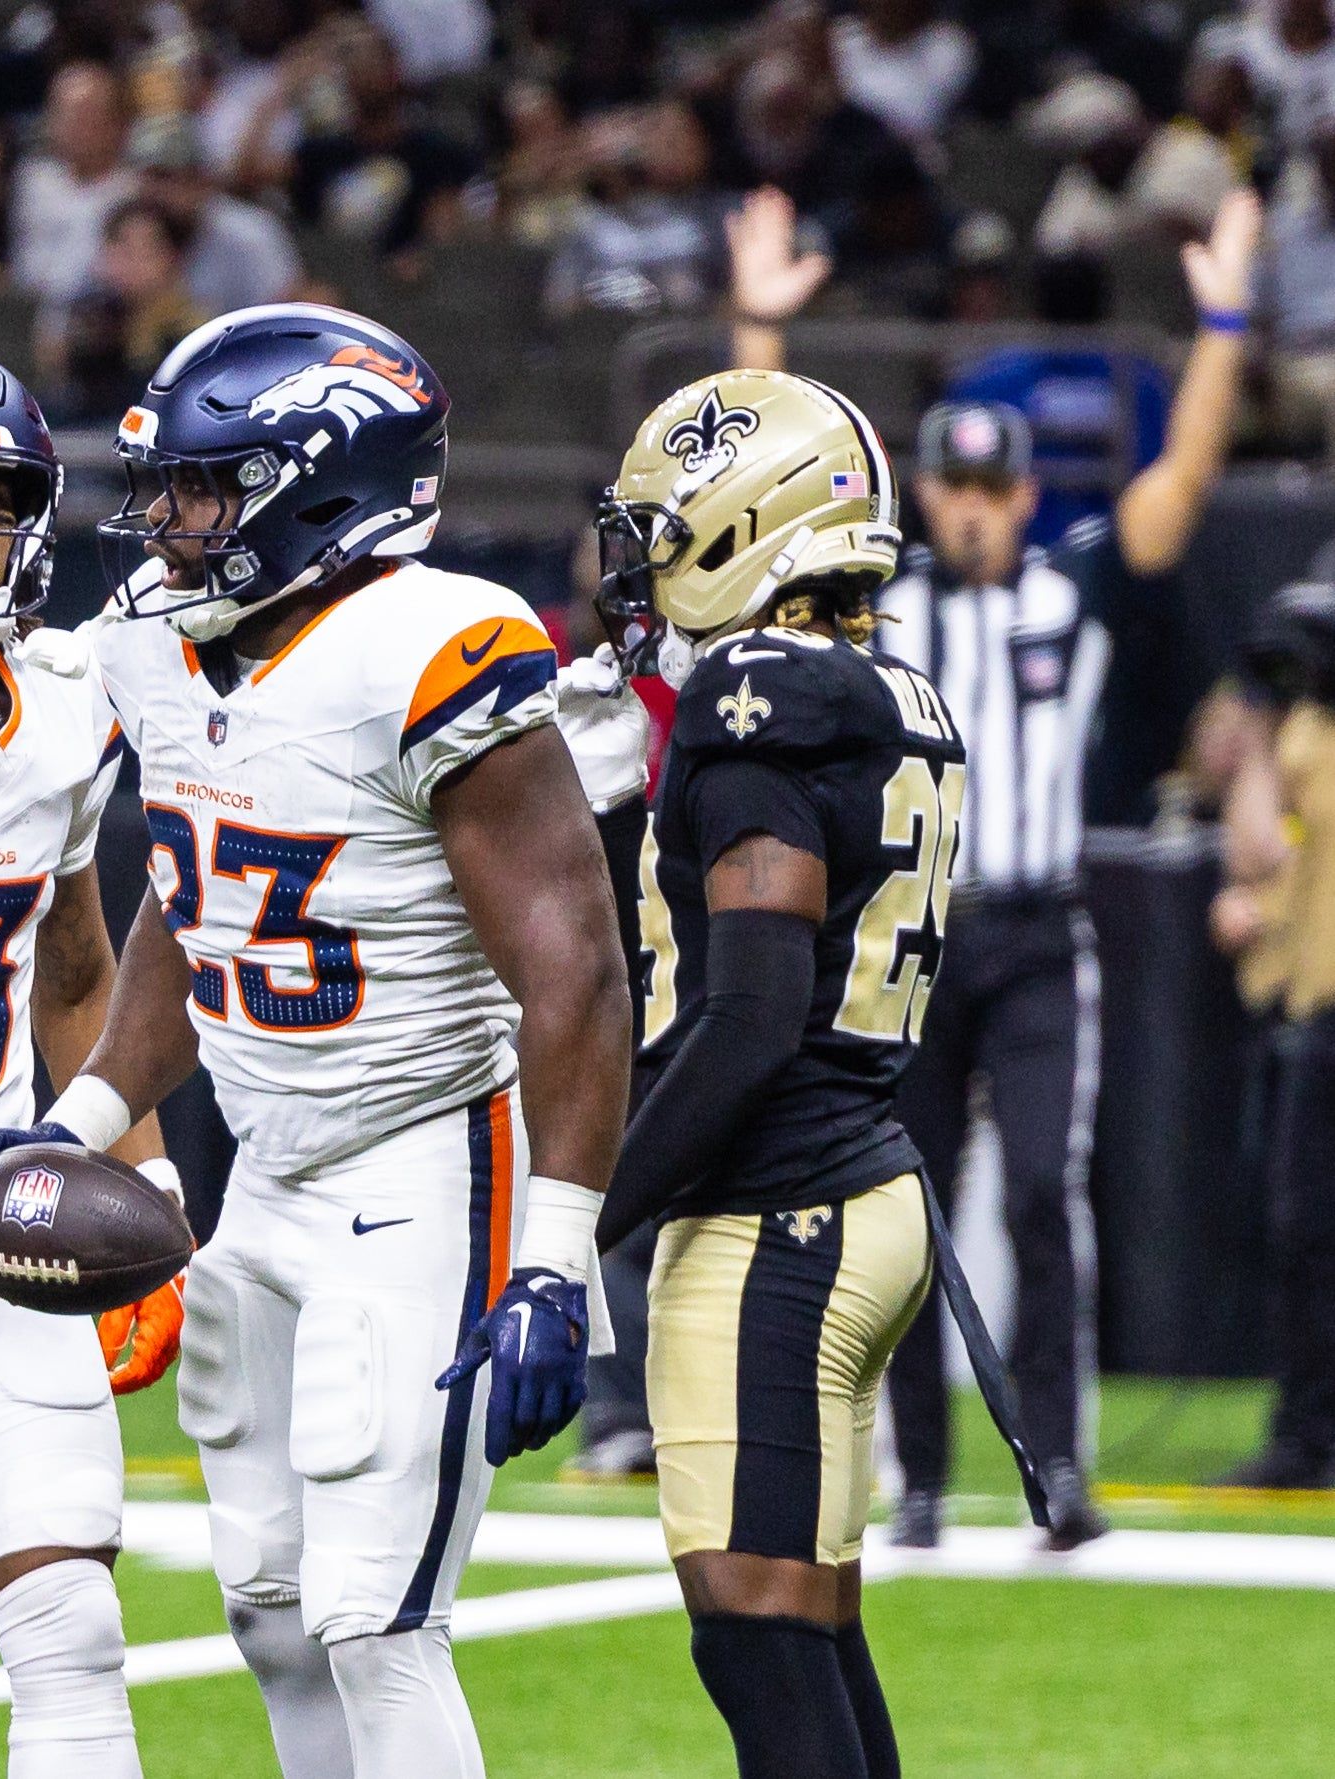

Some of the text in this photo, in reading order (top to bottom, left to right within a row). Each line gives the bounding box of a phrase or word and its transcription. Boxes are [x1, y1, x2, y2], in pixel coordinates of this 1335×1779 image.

[176, 782, 254, 810] BRONCOS
[143, 801, 366, 1032] 23
[17, 1169, 57, 1201] NFL
